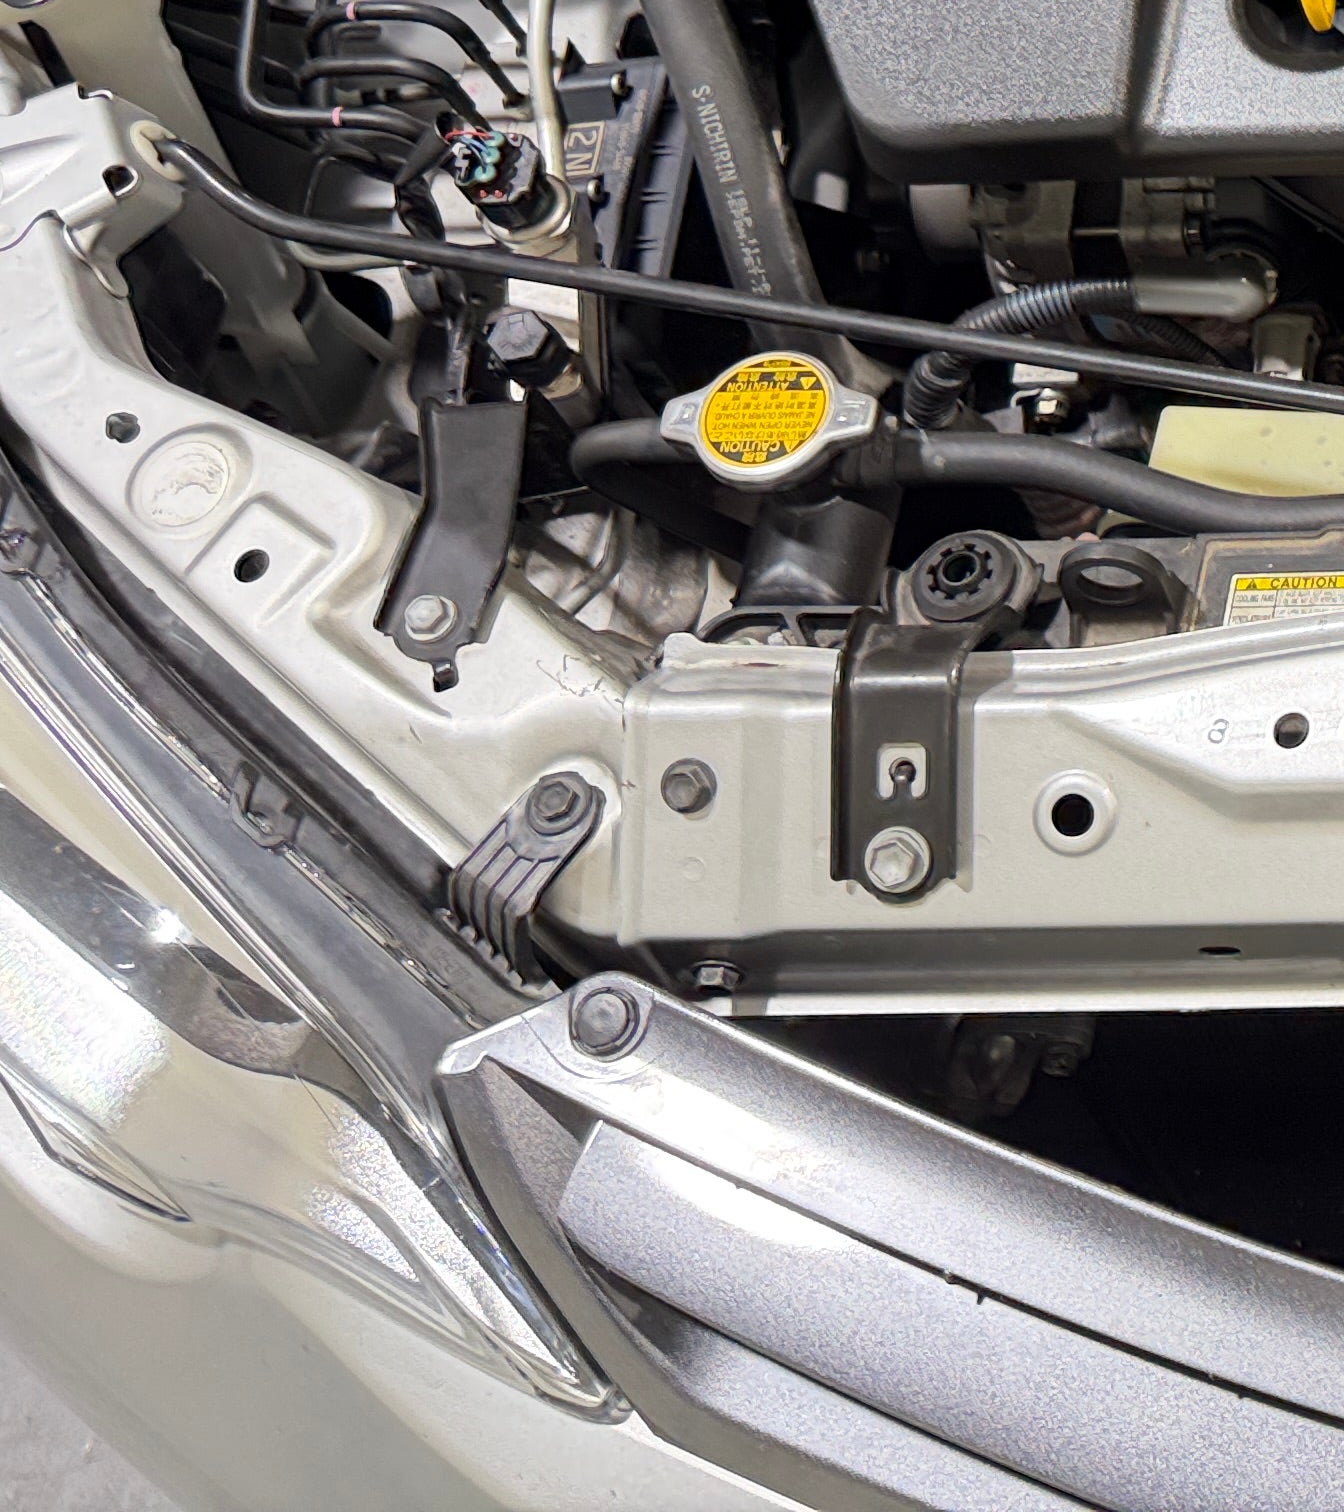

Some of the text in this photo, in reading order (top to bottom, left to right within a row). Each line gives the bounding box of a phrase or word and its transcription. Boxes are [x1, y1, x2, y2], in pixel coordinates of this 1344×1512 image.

[727, 382, 790, 392] ATTENTION
[720, 441, 780, 452] CAUTION
[1270, 577, 1337, 589] CAUTION
